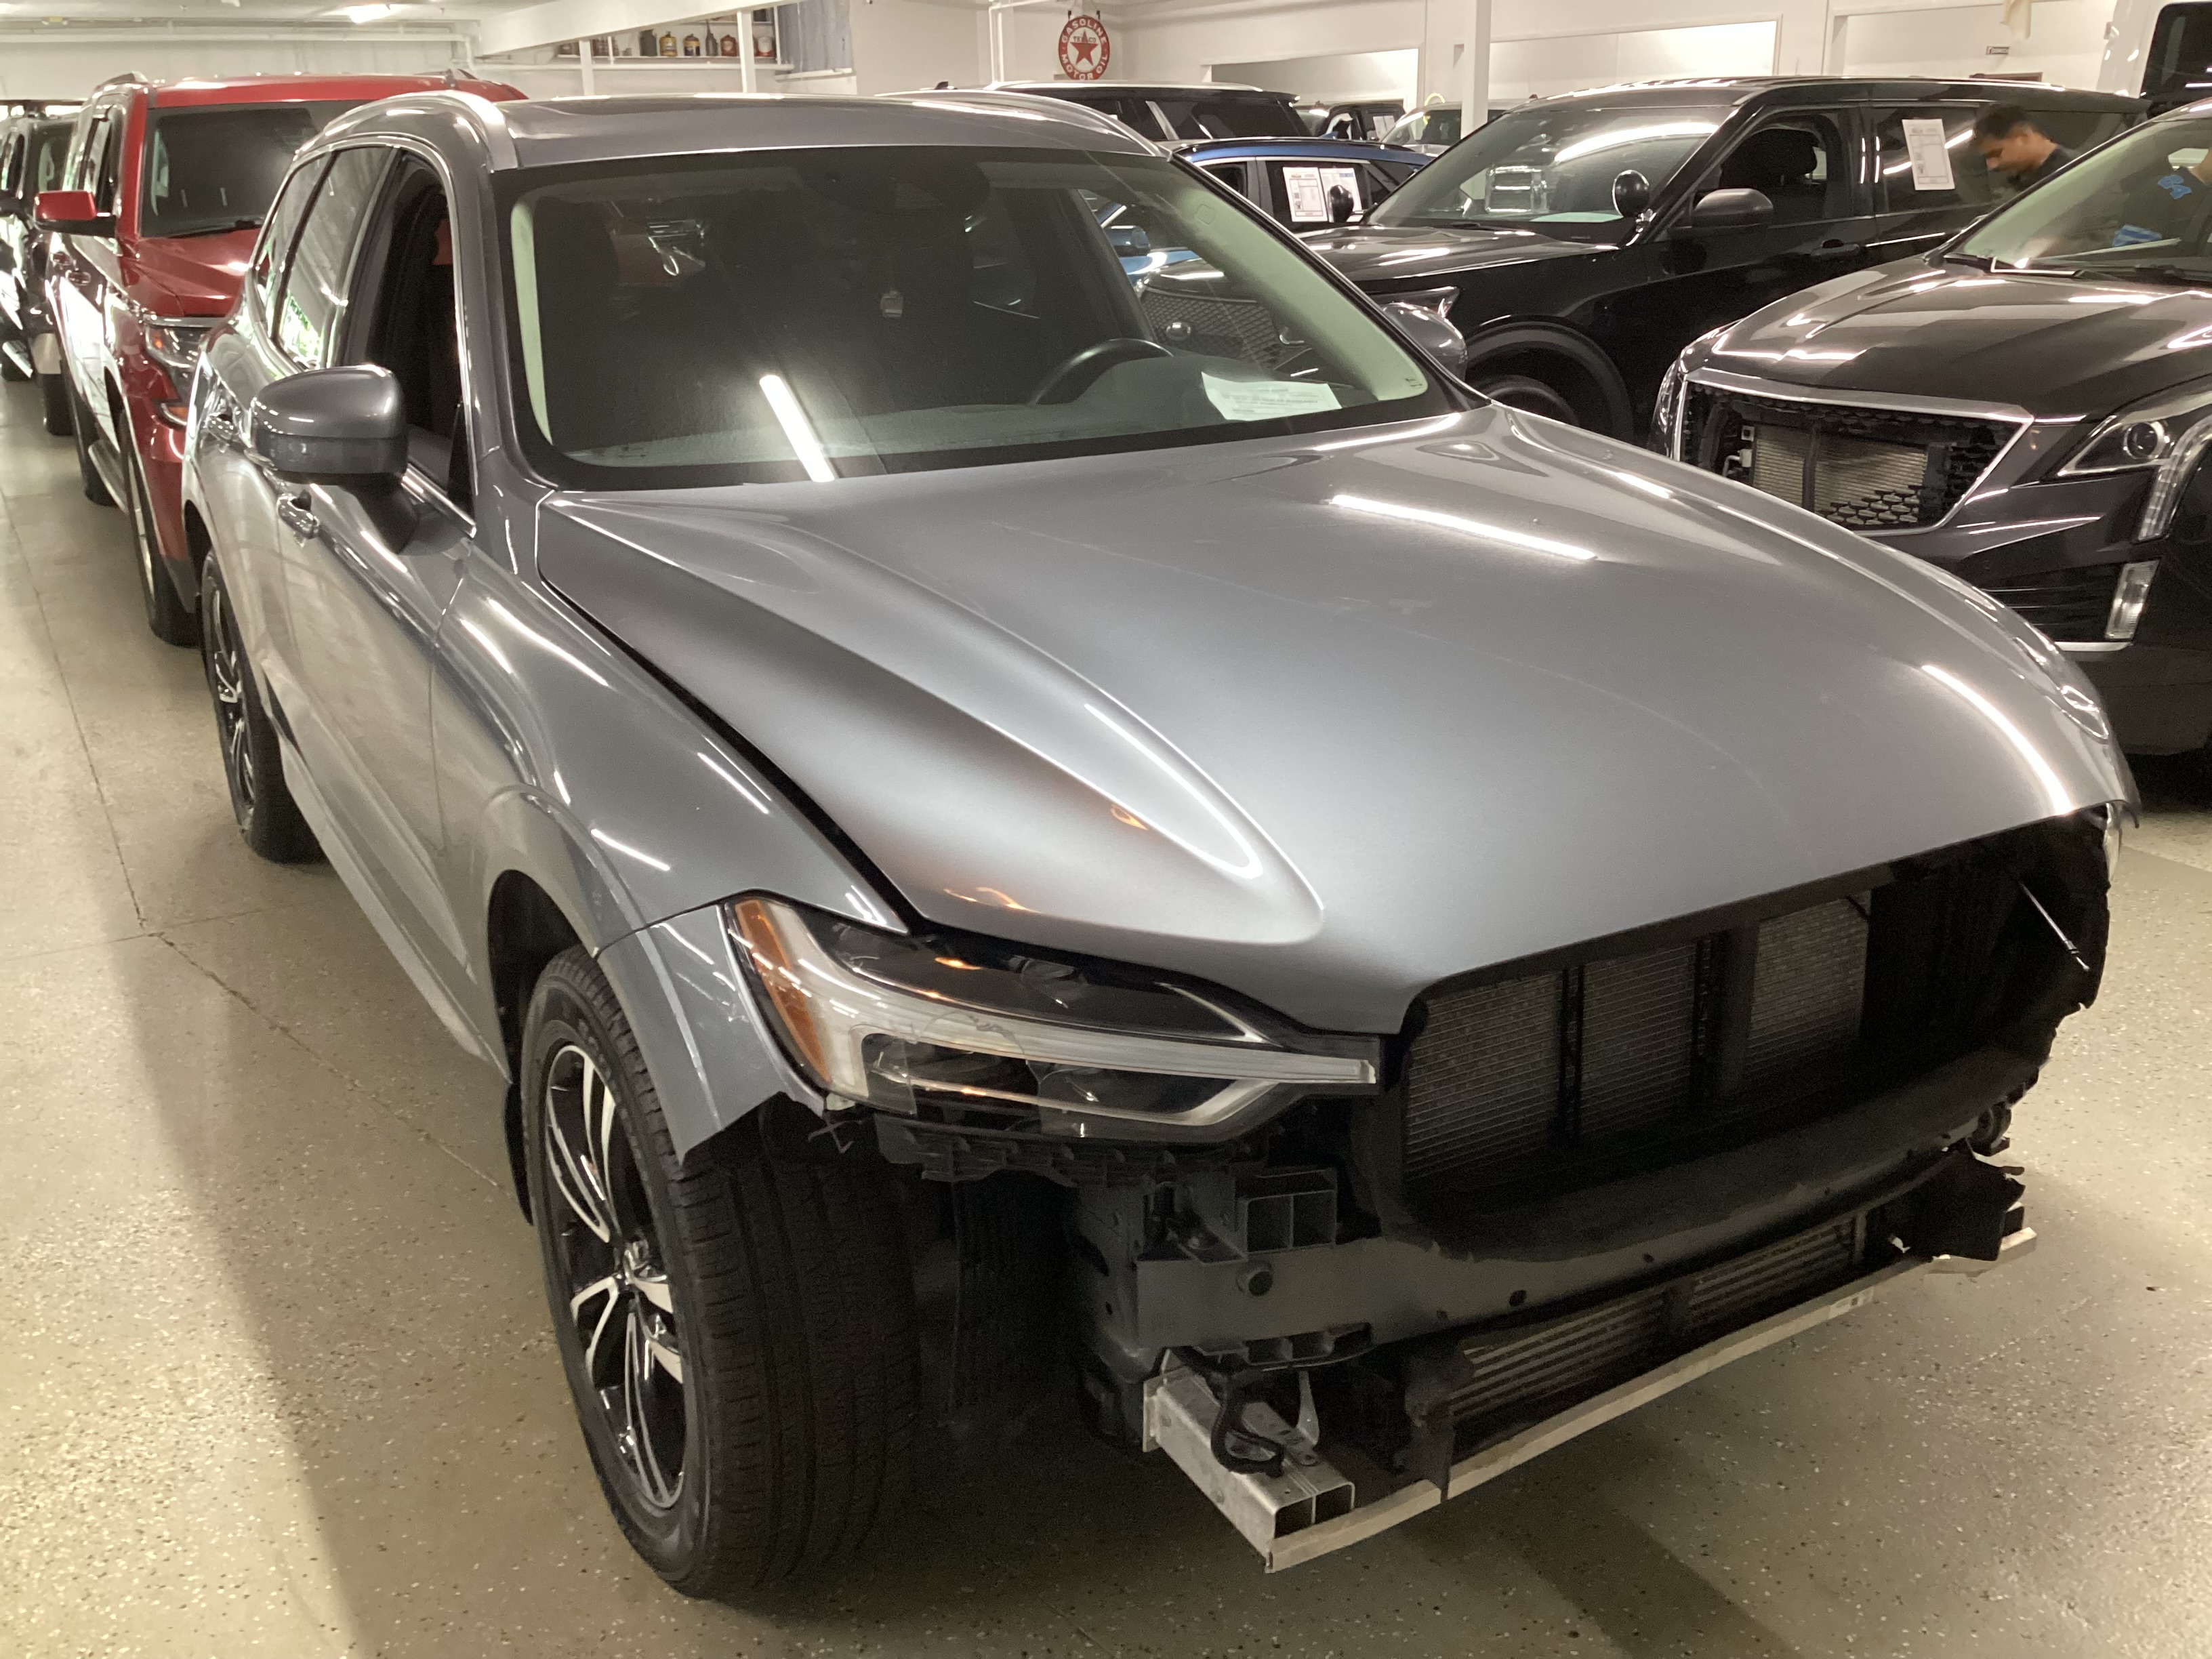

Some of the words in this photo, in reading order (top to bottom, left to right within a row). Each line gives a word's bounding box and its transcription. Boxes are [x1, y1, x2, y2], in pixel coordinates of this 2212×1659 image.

[1062, 18, 1107, 43] GASOLINE
[1061, 54, 1093, 79] MOTOR
[1096, 55, 1107, 74] OIL
